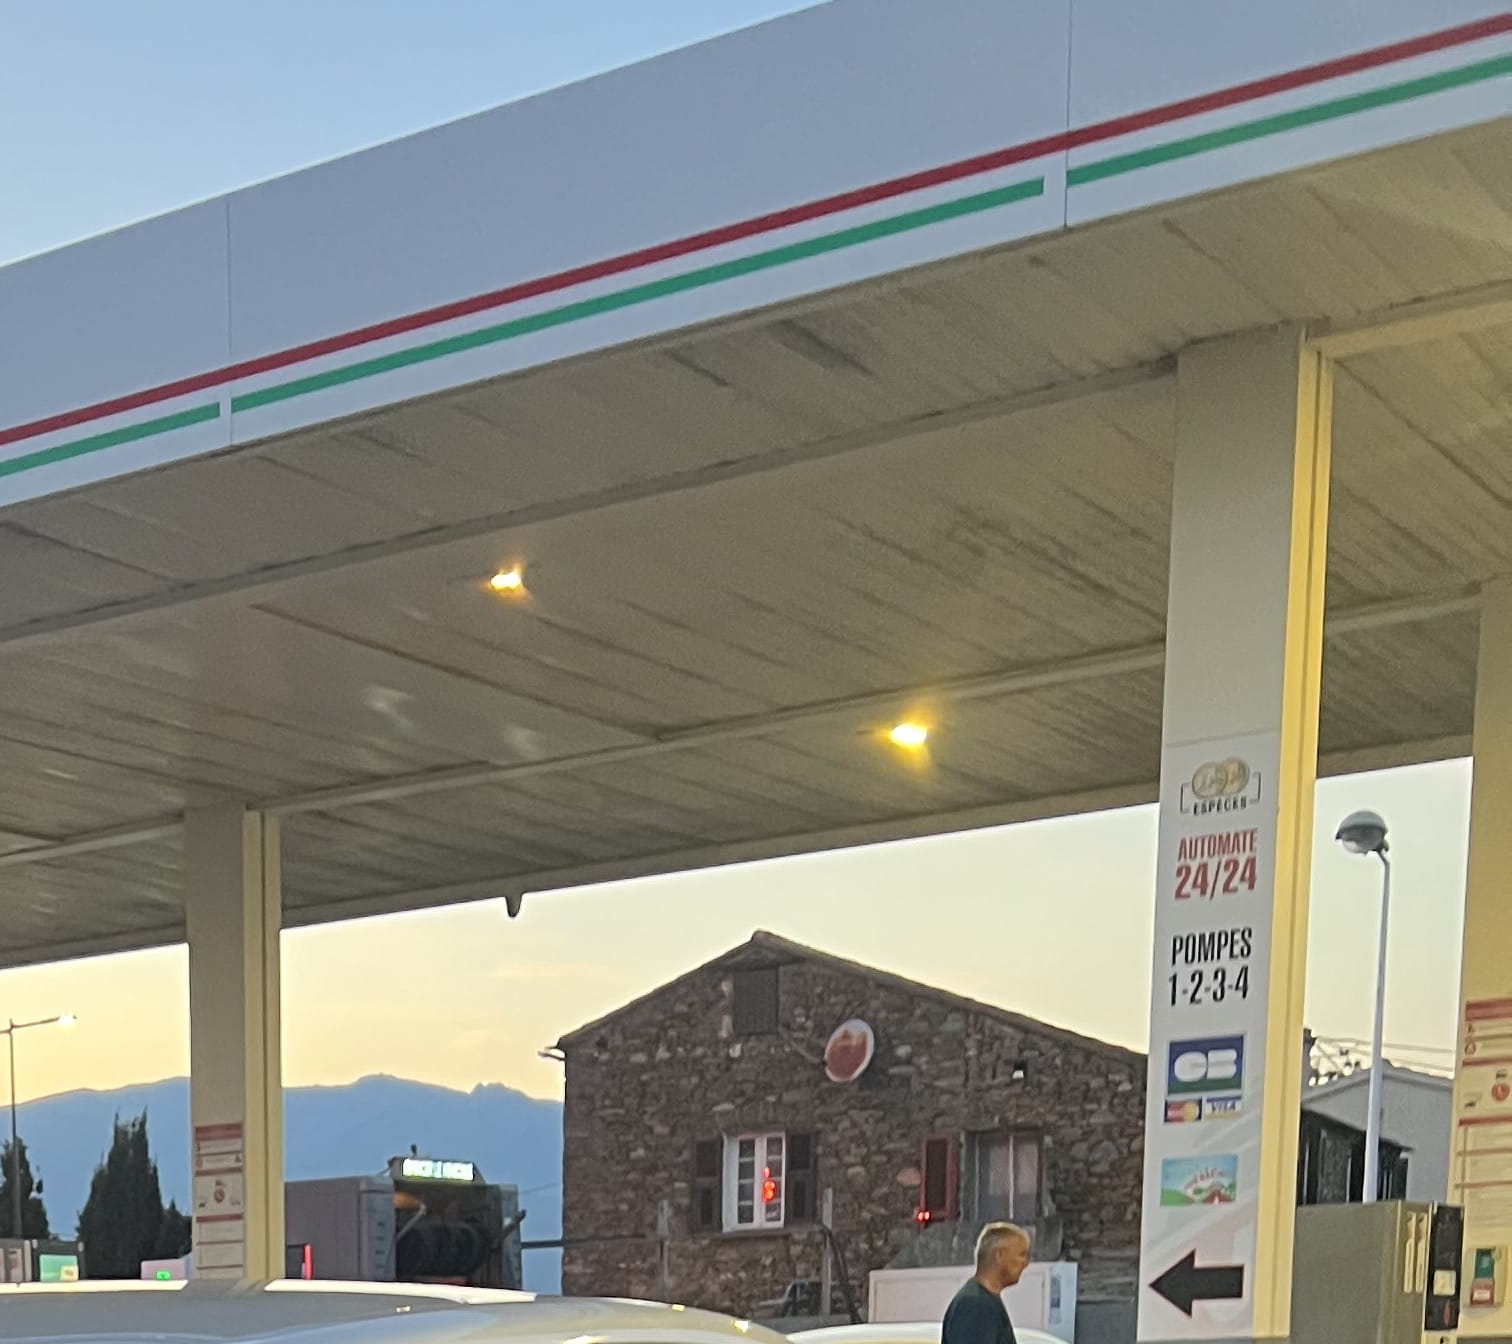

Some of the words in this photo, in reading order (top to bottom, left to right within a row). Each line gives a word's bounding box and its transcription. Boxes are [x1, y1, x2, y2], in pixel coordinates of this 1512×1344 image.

[1178, 828, 1258, 862] AUTOMATE
[1175, 856, 1257, 901] 24/24
[1172, 926, 1252, 967] POMPES
[1169, 965, 1248, 1007] 1-2-3-4
